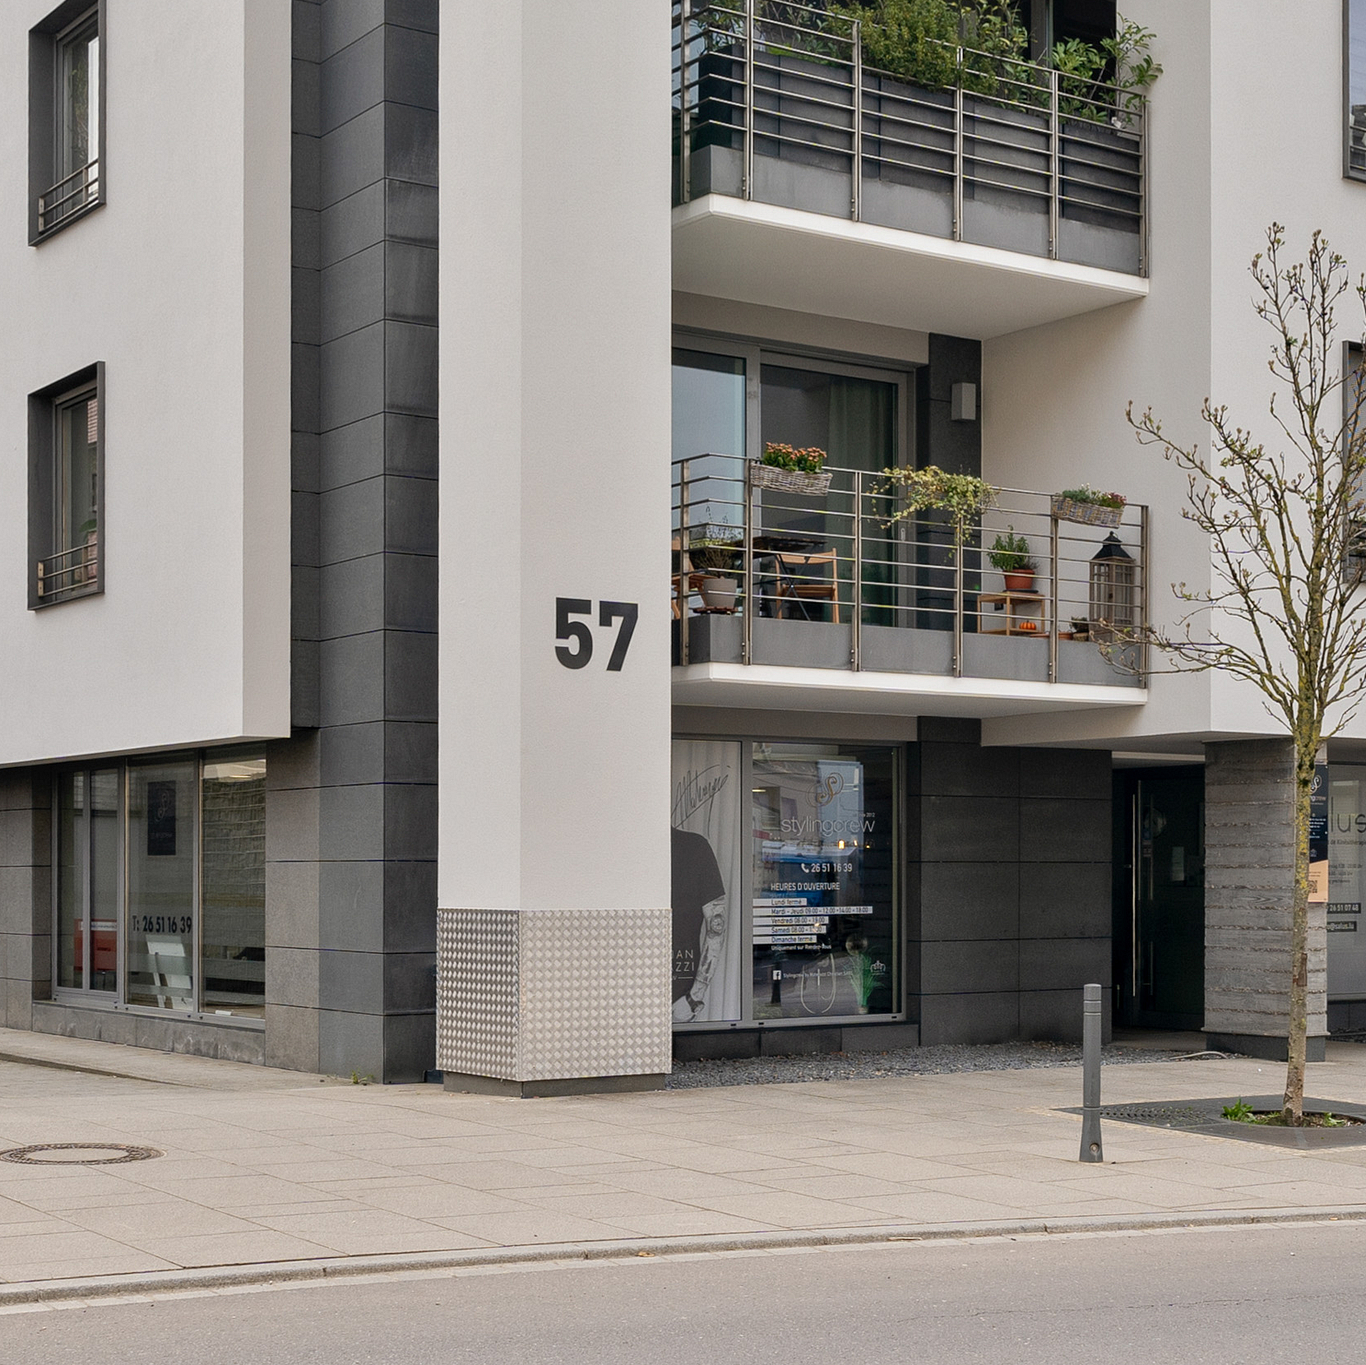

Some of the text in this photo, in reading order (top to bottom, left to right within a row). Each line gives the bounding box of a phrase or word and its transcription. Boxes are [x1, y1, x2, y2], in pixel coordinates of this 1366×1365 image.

[555, 597, 639, 672] 57
[780, 816, 876, 837] stylingcrew
[811, 863, 853, 873] 26 51 16 39
[770, 881, 841, 891] HEURES D'OUVERTURE
[1330, 904, 1337, 912] 26
[143, 915, 154, 933] 26
[156, 916, 165, 933] 51
[168, 916, 178, 933] 16
[180, 916, 193, 934] 39
